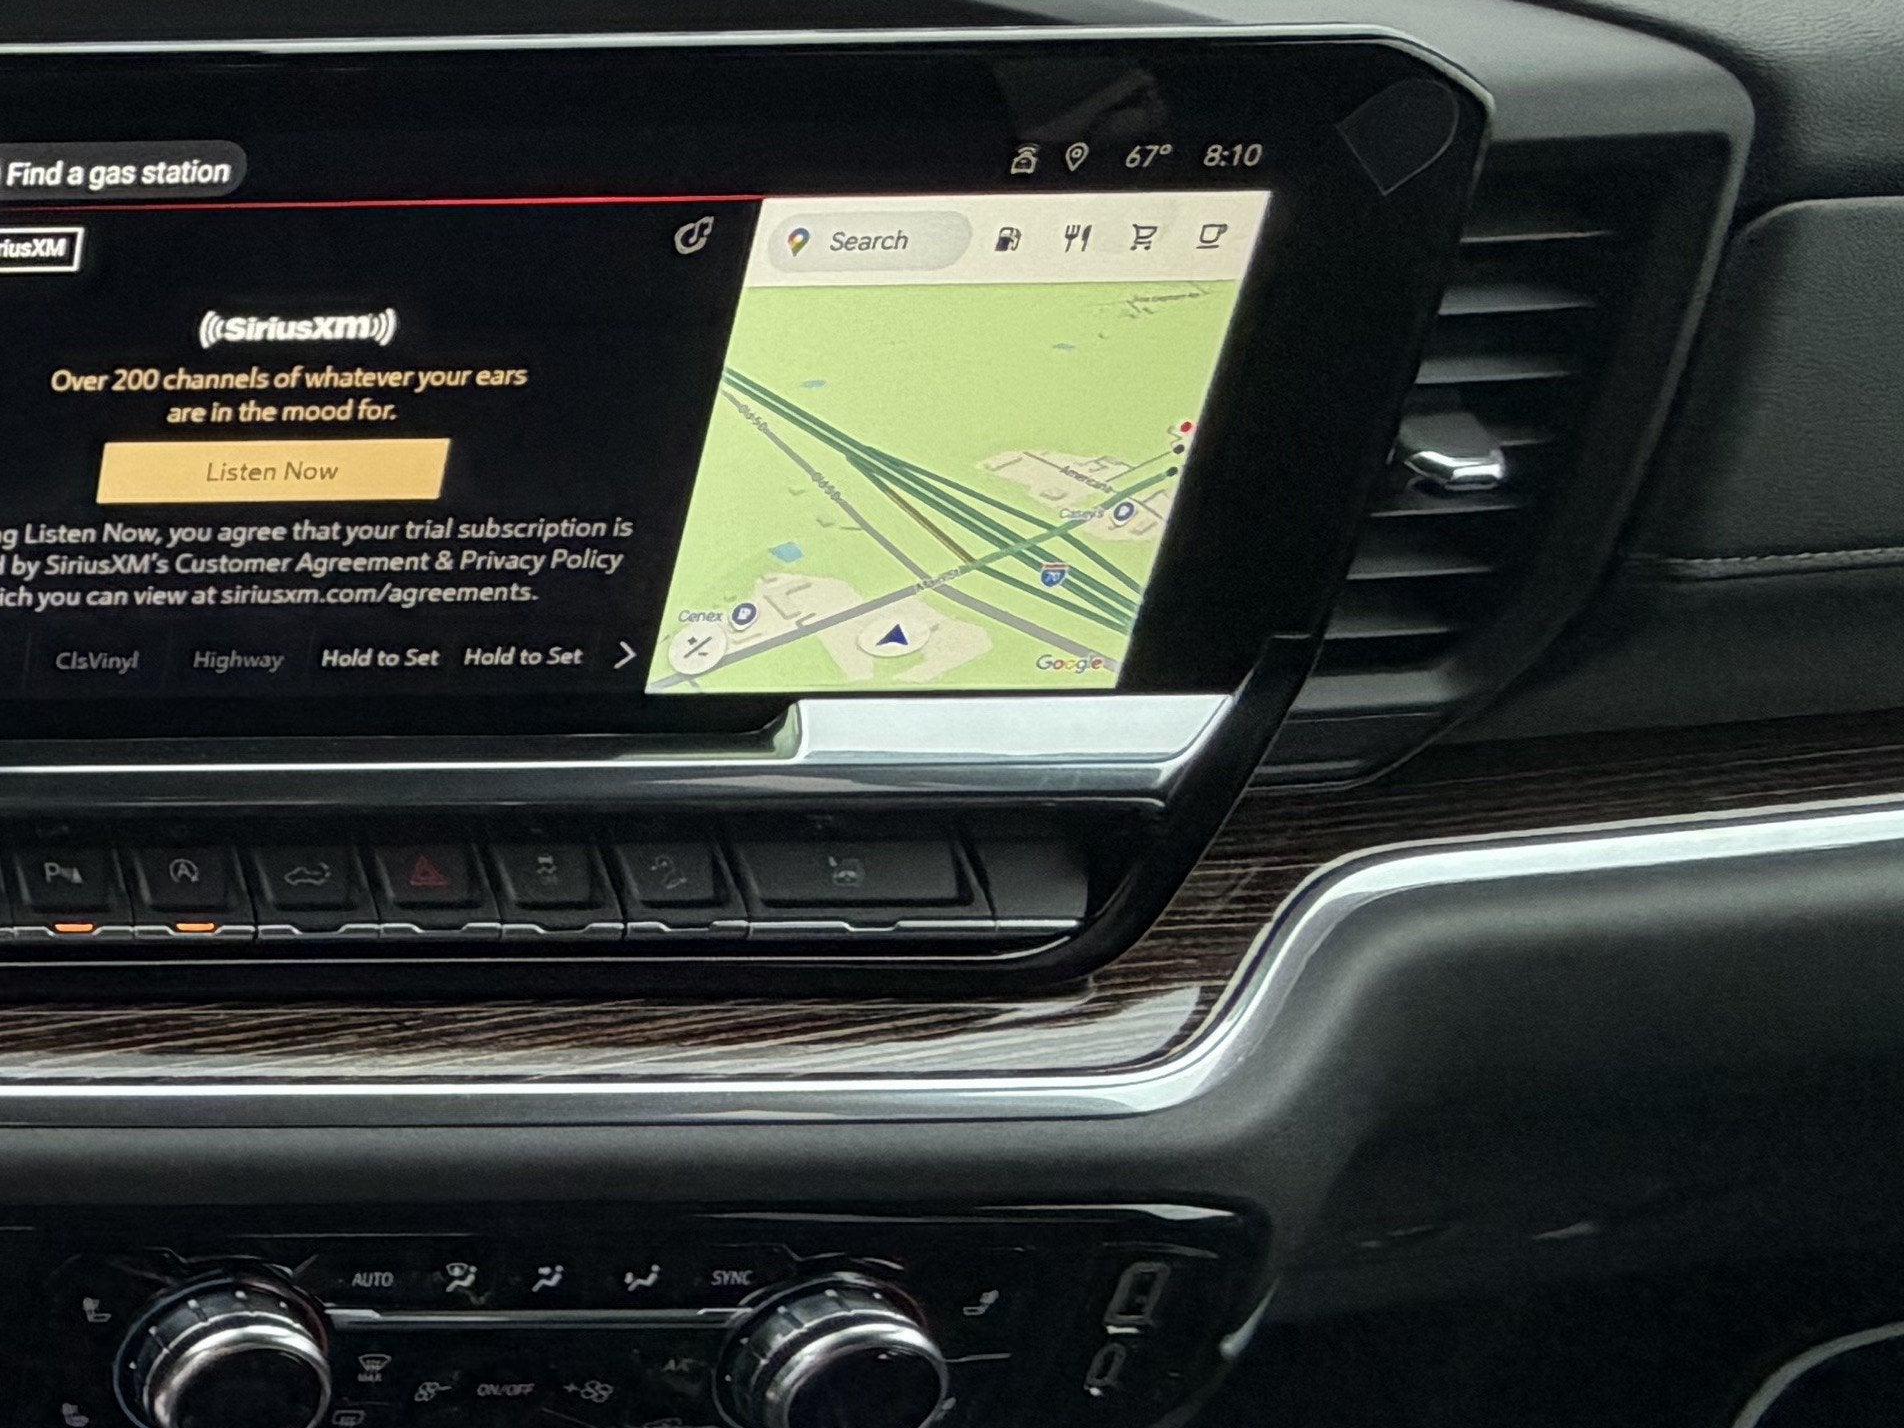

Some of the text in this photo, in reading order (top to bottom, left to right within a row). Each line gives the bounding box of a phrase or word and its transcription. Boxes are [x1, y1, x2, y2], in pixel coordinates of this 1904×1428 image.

[1125, 142, 1264, 169] 67° 8:10
[5, 160, 231, 191] Find a gas station
[828, 229, 909, 253] Search
[222, 315, 374, 342] SiriusXM
[50, 366, 529, 393] Over 200 channels of whatever your ears
[166, 397, 398, 423] are in the mood for.
[205, 461, 339, 482] Listen Now
[24, 522, 97, 545] Listen
[101, 521, 163, 547] Now,
[166, 527, 213, 548] you
[217, 526, 289, 548] agree
[292, 519, 342, 541] that
[342, 523, 401, 546] your
[405, 517, 455, 540] trial
[457, 517, 608, 544] subscription
[612, 517, 634, 538] is
[12, 554, 41, 582] by
[44, 552, 170, 577] SiriusXM's
[174, 552, 292, 575] Customer
[293, 552, 433, 578] Agreement
[435, 551, 454, 572] &
[459, 550, 547, 576] Privacy
[550, 549, 624, 574] Policy
[35, 590, 82, 612] you
[85, 589, 129, 607] can
[133, 586, 190, 606] view
[191, 587, 220, 605] at
[220, 584, 540, 609] siriusxm.com/agreements.
[54, 651, 140, 673] ClsVinyl
[193, 650, 286, 674] Highway
[320, 648, 441, 668] Hold to Set
[463, 647, 584, 666] Hold to Set
[1036, 653, 1104, 674] Google
[351, 1271, 395, 1288] AUTO
[711, 1270, 754, 1287] SYNC
[476, 1382, 535, 1396] ON/OFF
